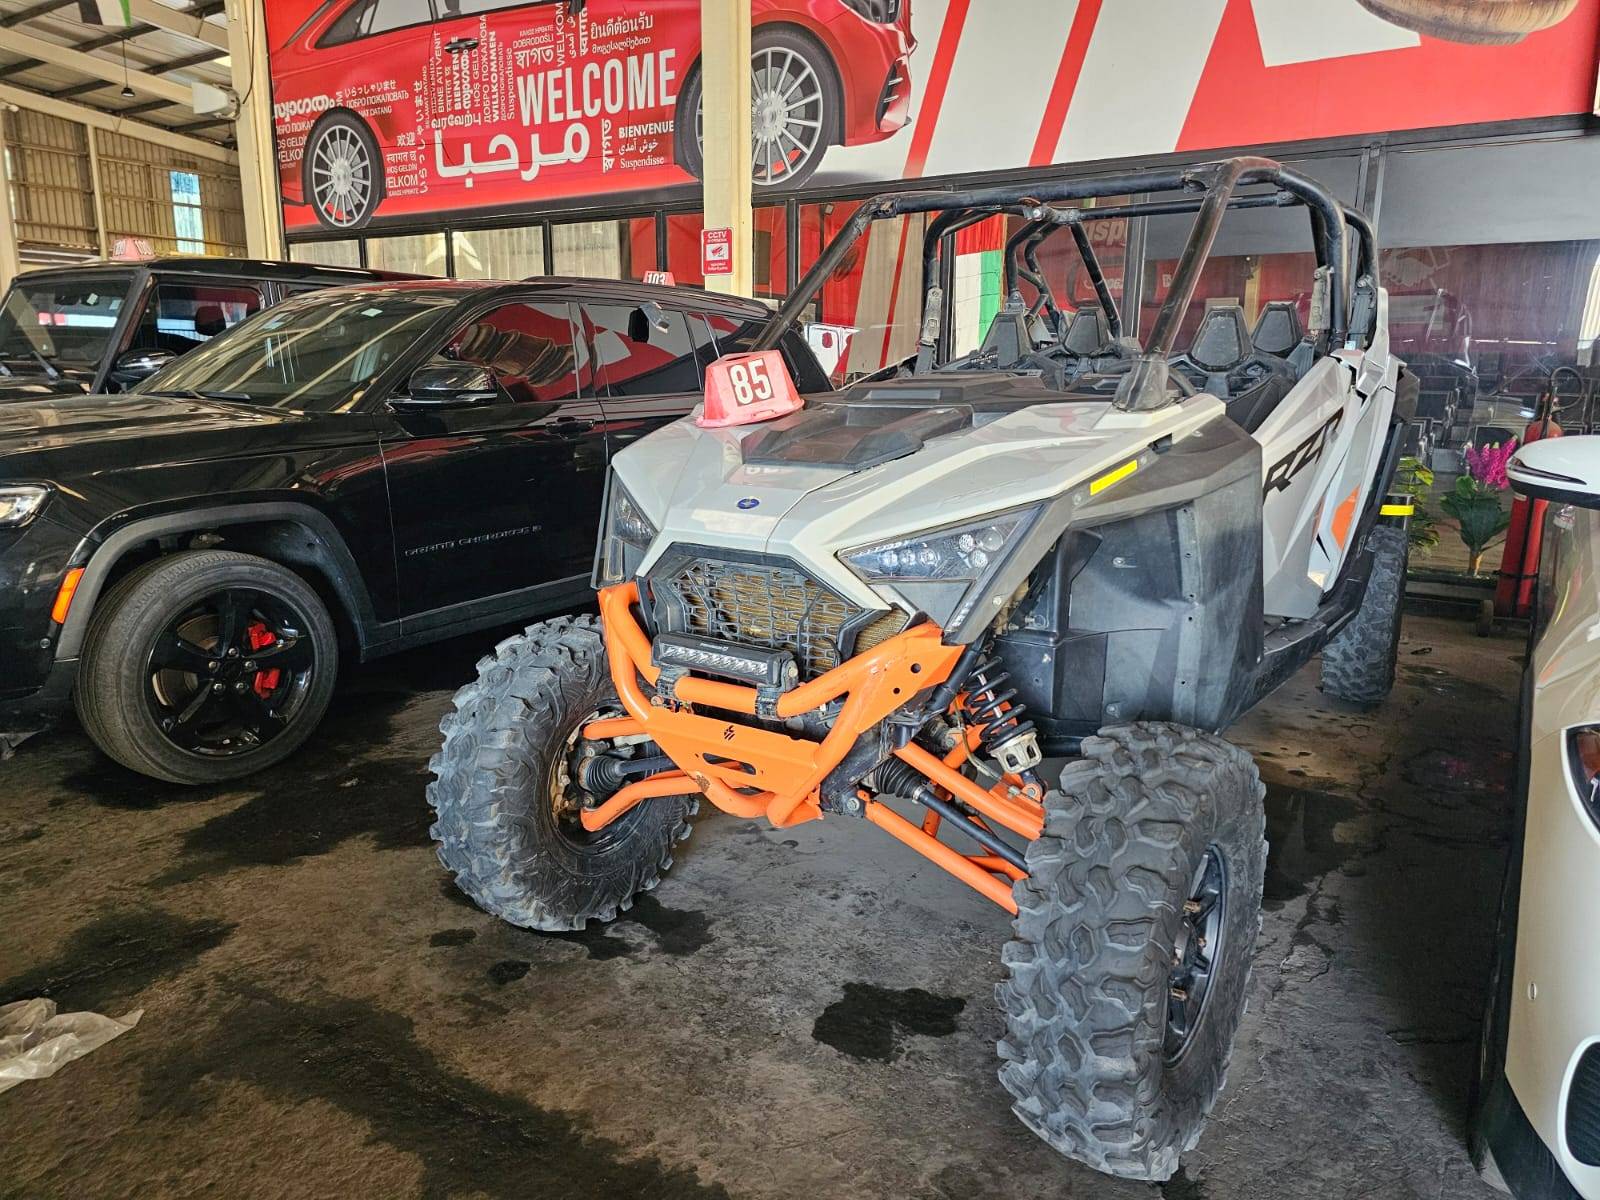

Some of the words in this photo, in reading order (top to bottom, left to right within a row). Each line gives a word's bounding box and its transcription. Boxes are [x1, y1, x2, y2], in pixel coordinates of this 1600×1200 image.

[433, 31, 442, 64] VENIT
[556, 2, 567, 67] WELKOM
[451, 36, 462, 110] BIENVENE
[489, 31, 499, 122] WILLKOMMEN
[506, 47, 515, 120] Suspendisse
[517, 48, 677, 127] WELCOME
[437, 87, 446, 113] BINE
[482, 84, 492, 123] ДОБРО
[414, 80, 428, 194] いらっしゃいませ
[618, 120, 675, 139] BIENVENUE
[434, 121, 591, 188] مرحبا
[620, 155, 664, 171] Suspendisse
[707, 231, 727, 239] CCTV
[730, 358, 772, 405] 85
[404, 540, 456, 556] GRAND
